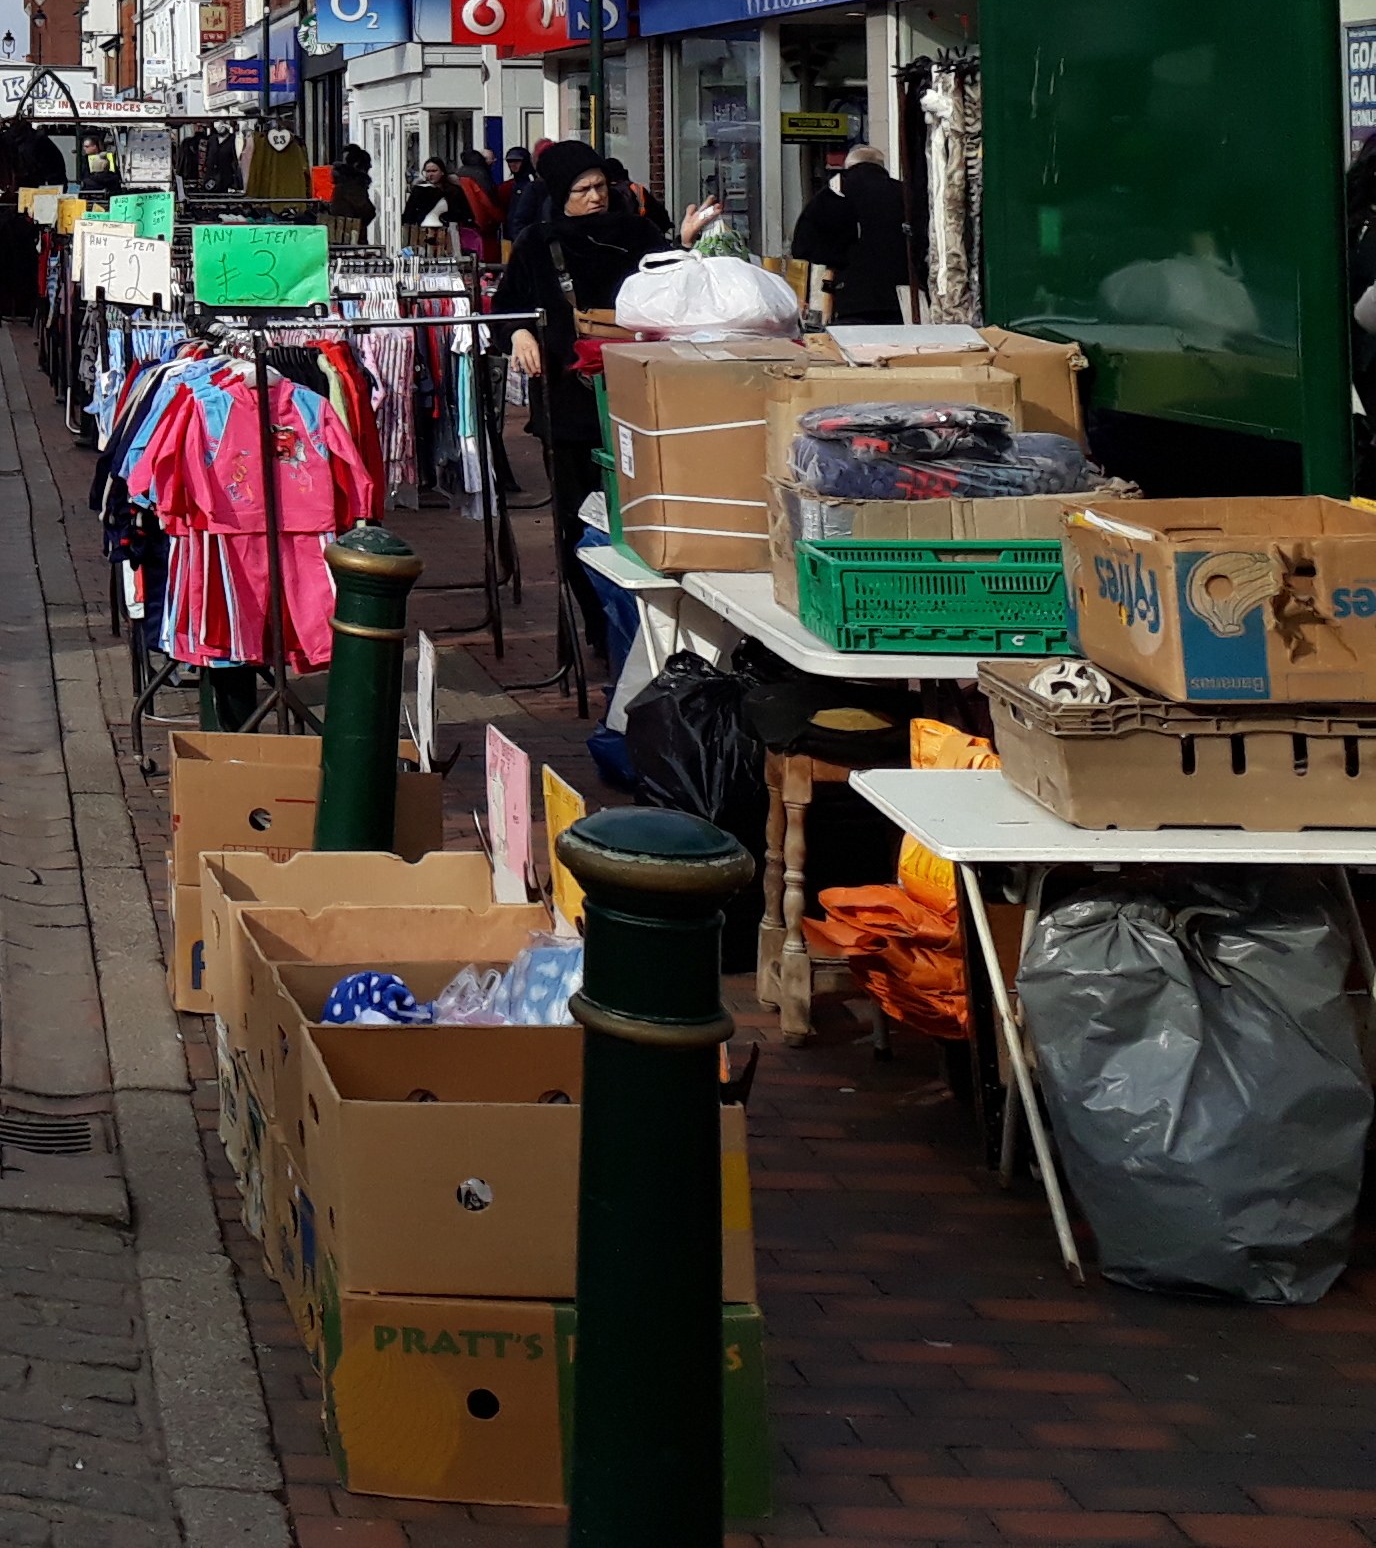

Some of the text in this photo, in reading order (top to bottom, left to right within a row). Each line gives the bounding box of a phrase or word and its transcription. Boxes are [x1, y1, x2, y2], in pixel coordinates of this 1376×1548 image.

[90, 235, 155, 252] ANY ITEM
[202, 227, 298, 246] ANY ITEM
[100, 253, 150, 301] £2
[216, 249, 280, 305] £3
[1190, 676, 1265, 692] Bananas
[373, 1324, 545, 1361] PRATT'S
